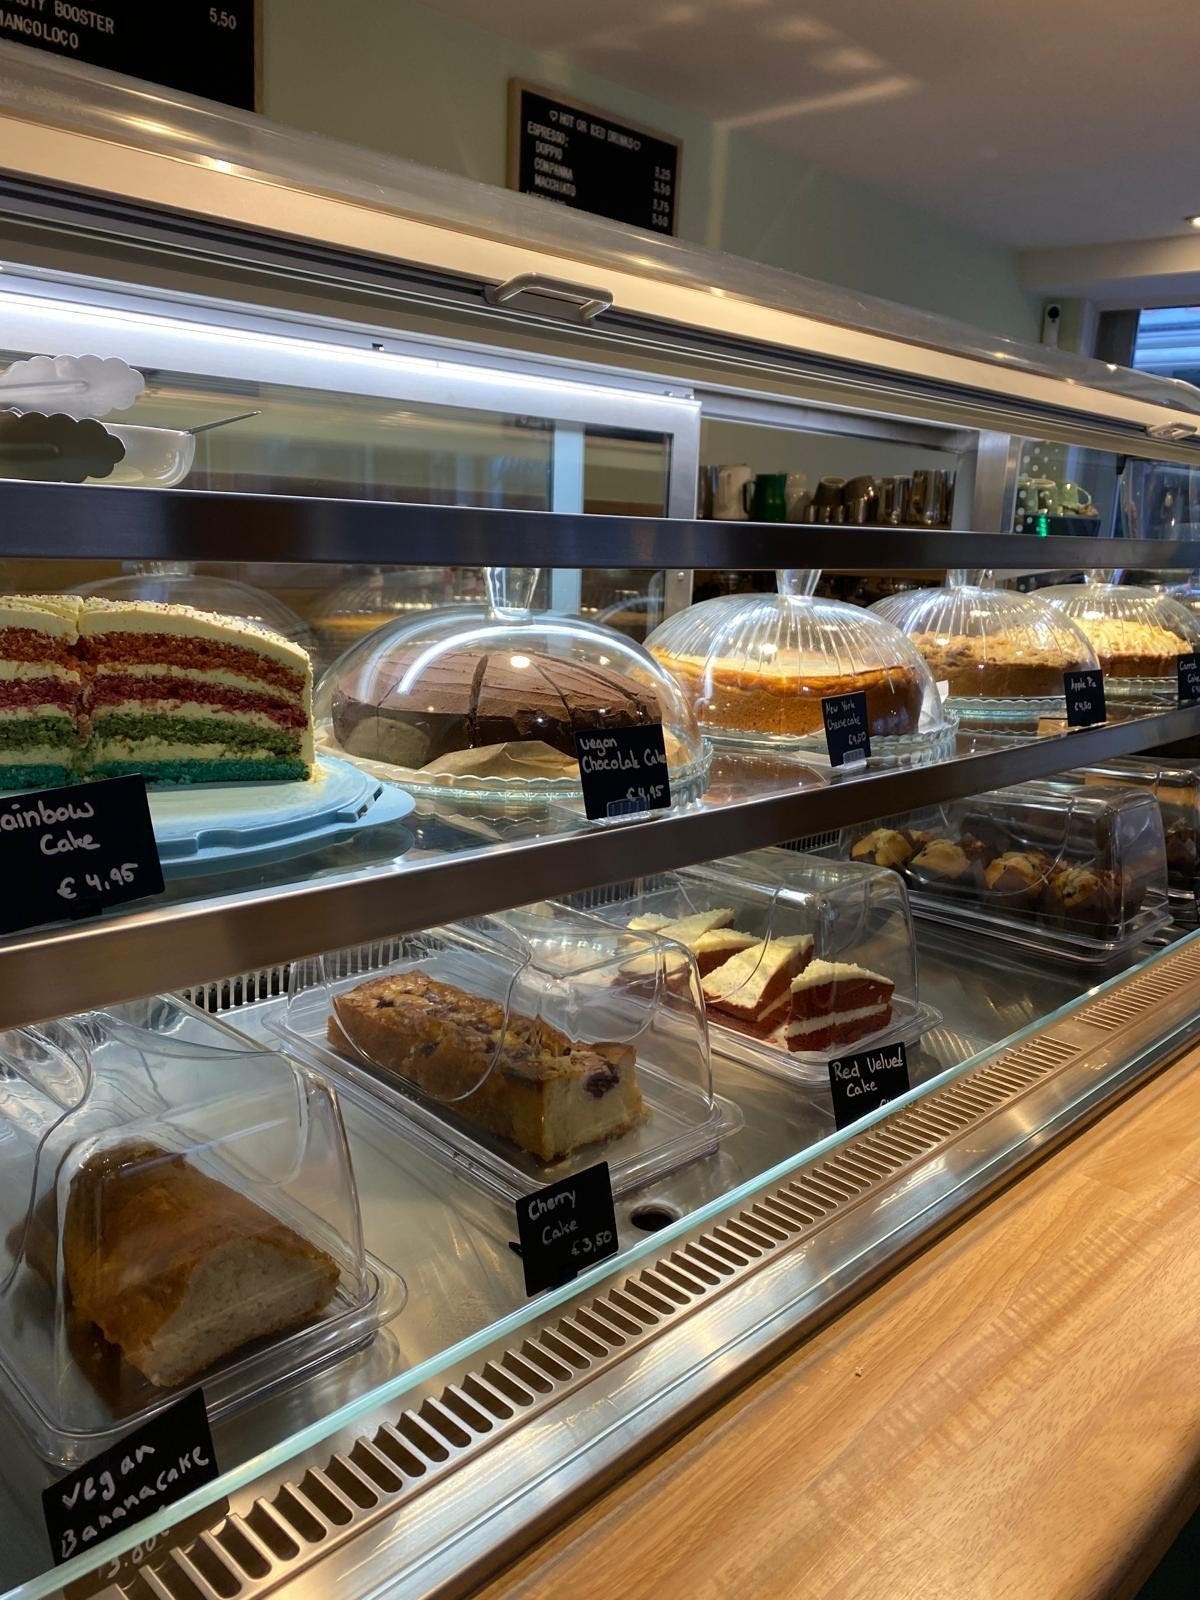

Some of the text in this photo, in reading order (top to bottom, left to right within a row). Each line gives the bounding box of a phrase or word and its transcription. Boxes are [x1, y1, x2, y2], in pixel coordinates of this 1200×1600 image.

[54, 1, 115, 35] BOOSTER
[576, 118, 588, 133] OR
[535, 140, 563, 161] DOPPIO
[1071, 678, 1086, 693] Apple
[825, 698, 856, 715] New York
[582, 750, 641, 773] Chocolate
[0, 800, 94, 831] ainbow
[39, 830, 101, 855] Cake
[832, 1046, 904, 1080] Red Velvet
[846, 1079, 878, 1097] Cake
[528, 1189, 576, 1221] Cherry
[542, 1220, 579, 1245] Cake
[62, 1445, 155, 1510] Vegan
